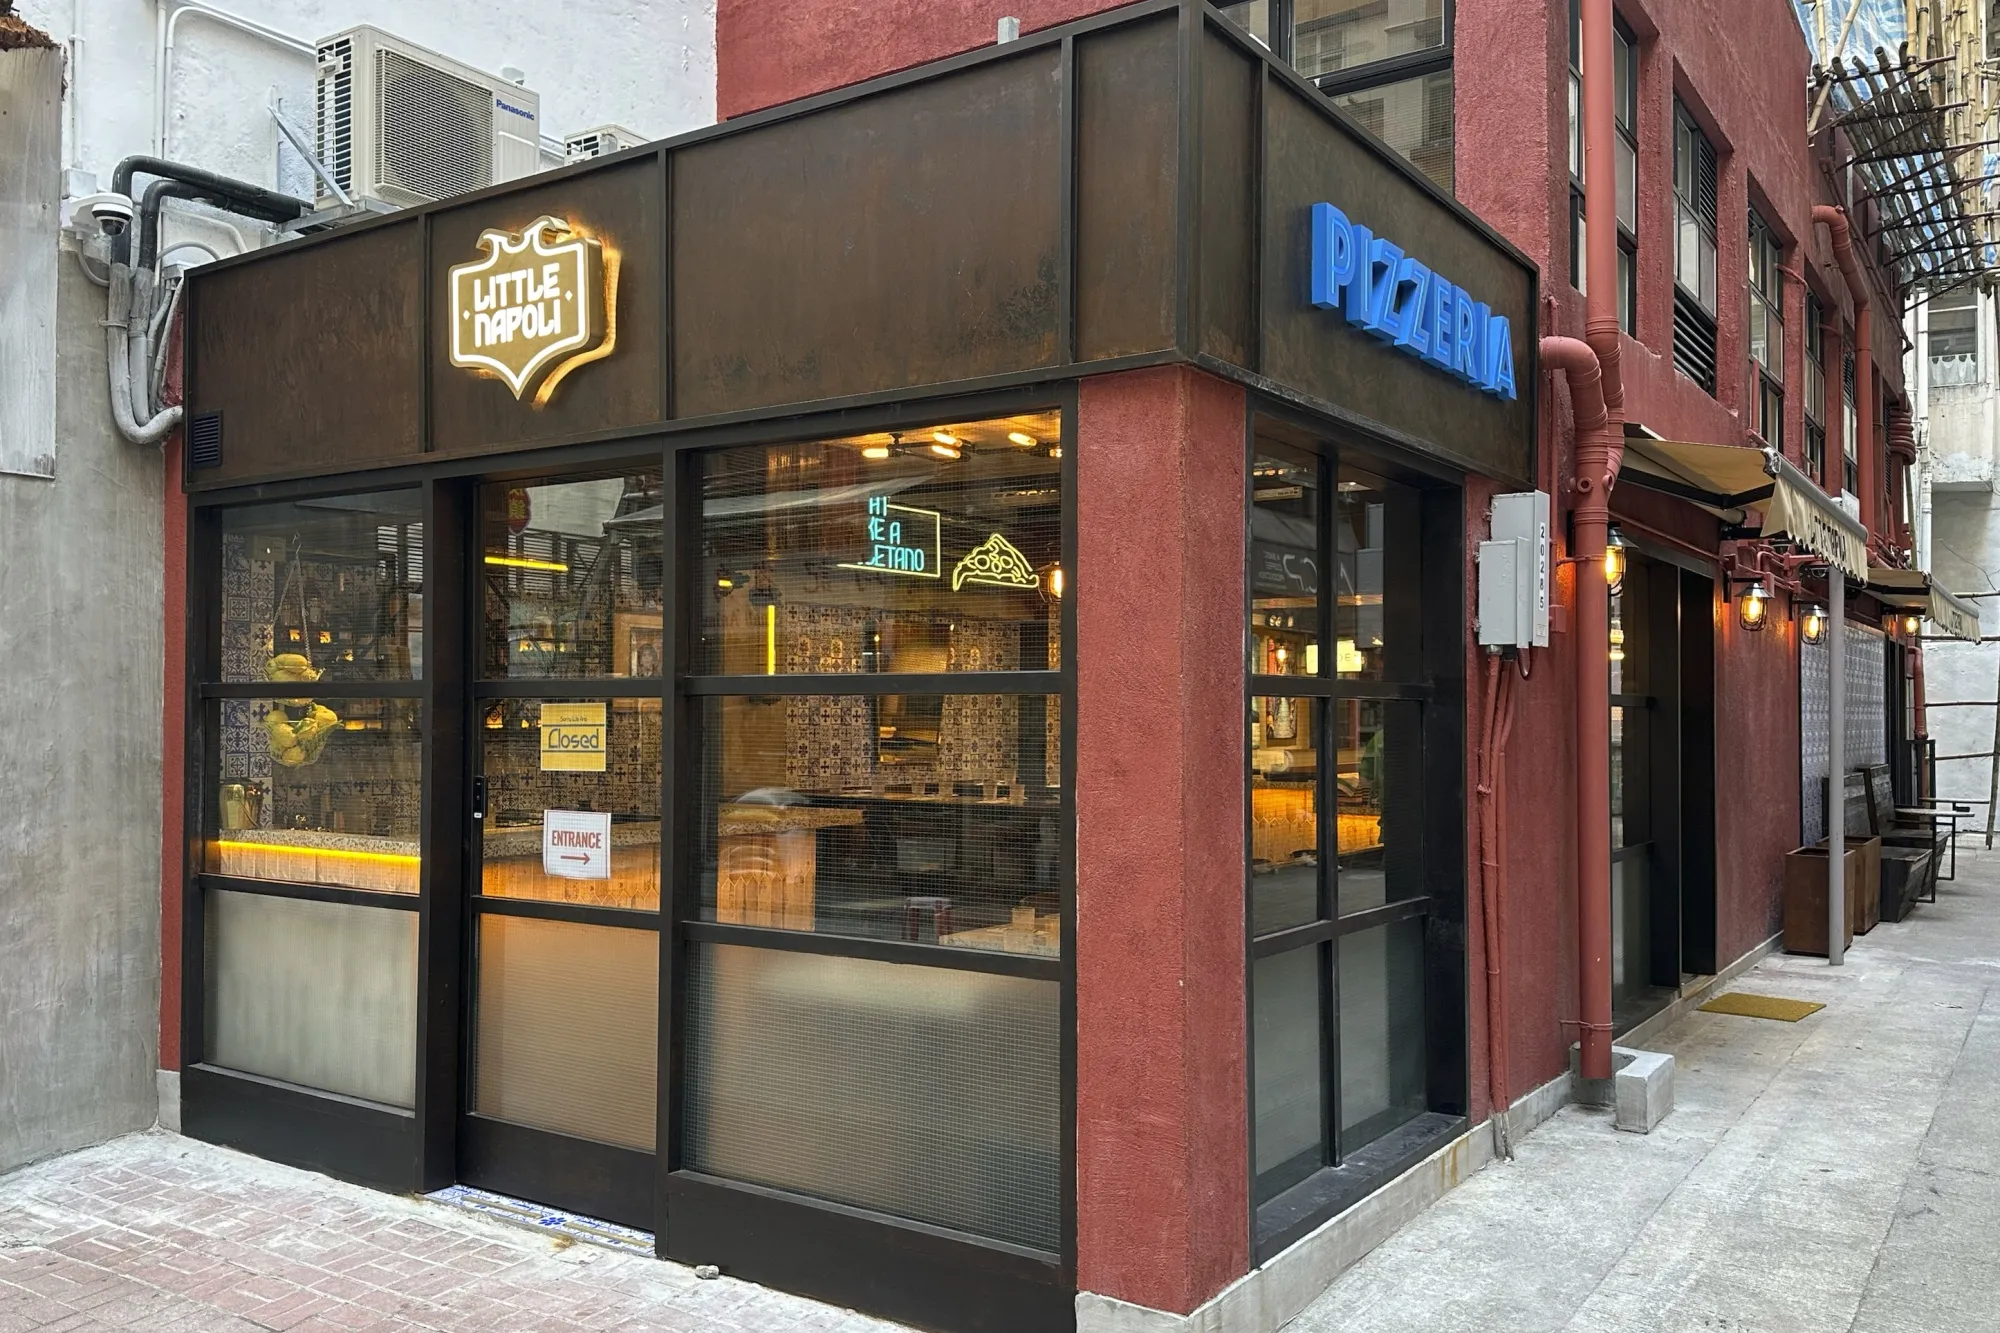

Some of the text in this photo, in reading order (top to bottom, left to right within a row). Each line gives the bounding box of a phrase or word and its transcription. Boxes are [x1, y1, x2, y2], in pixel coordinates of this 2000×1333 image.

[496, 98, 535, 121] Panasonic
[473, 262, 561, 312] LITTLE
[1312, 202, 1518, 401] PIZZERIA
[474, 299, 562, 349] NAPOLI
[889, 521, 901, 545] A
[548, 728, 600, 749] Closed
[551, 829, 602, 849] ENTRANCE
